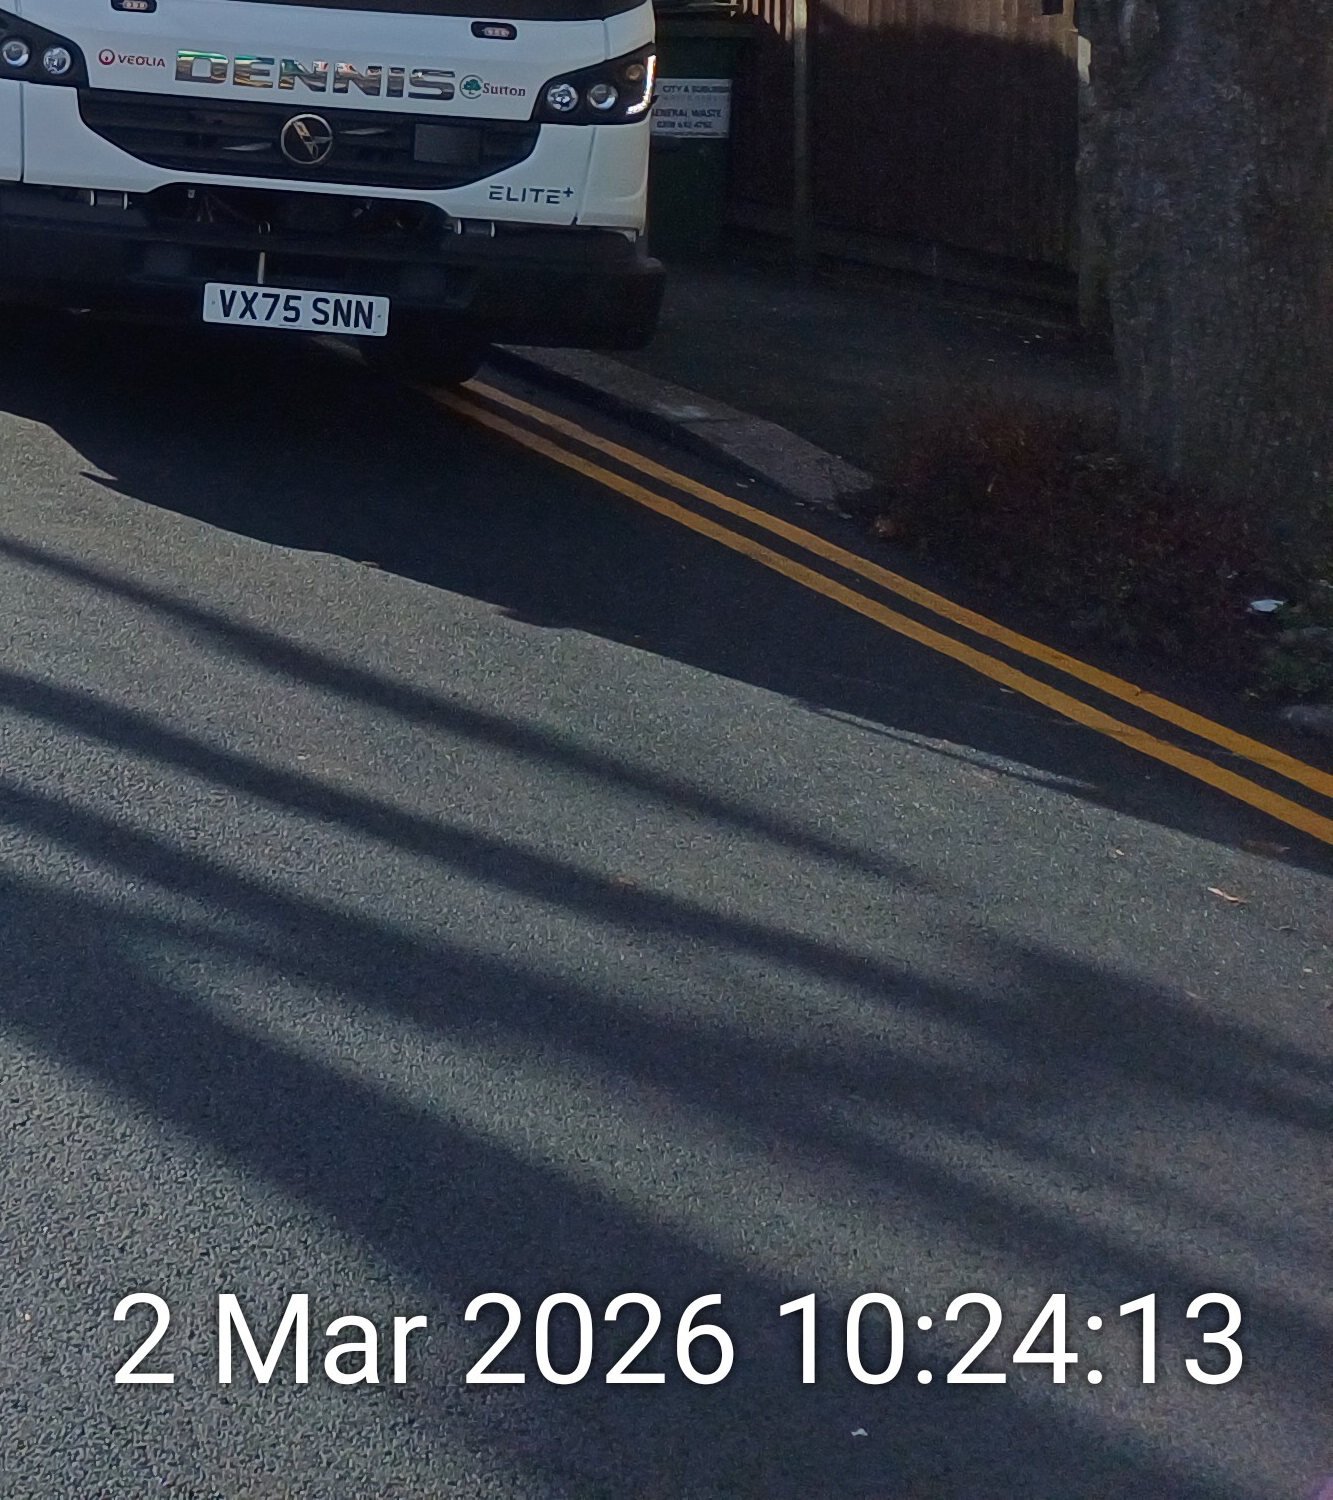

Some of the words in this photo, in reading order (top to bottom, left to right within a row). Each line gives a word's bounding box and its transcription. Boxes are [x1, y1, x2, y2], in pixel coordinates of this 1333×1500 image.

[117, 54, 166, 68] VEOLIA
[174, 49, 456, 101] DENNIS
[482, 82, 527, 98] Sutton
[219, 288, 302, 324] VX75
[311, 296, 374, 330] SNN
